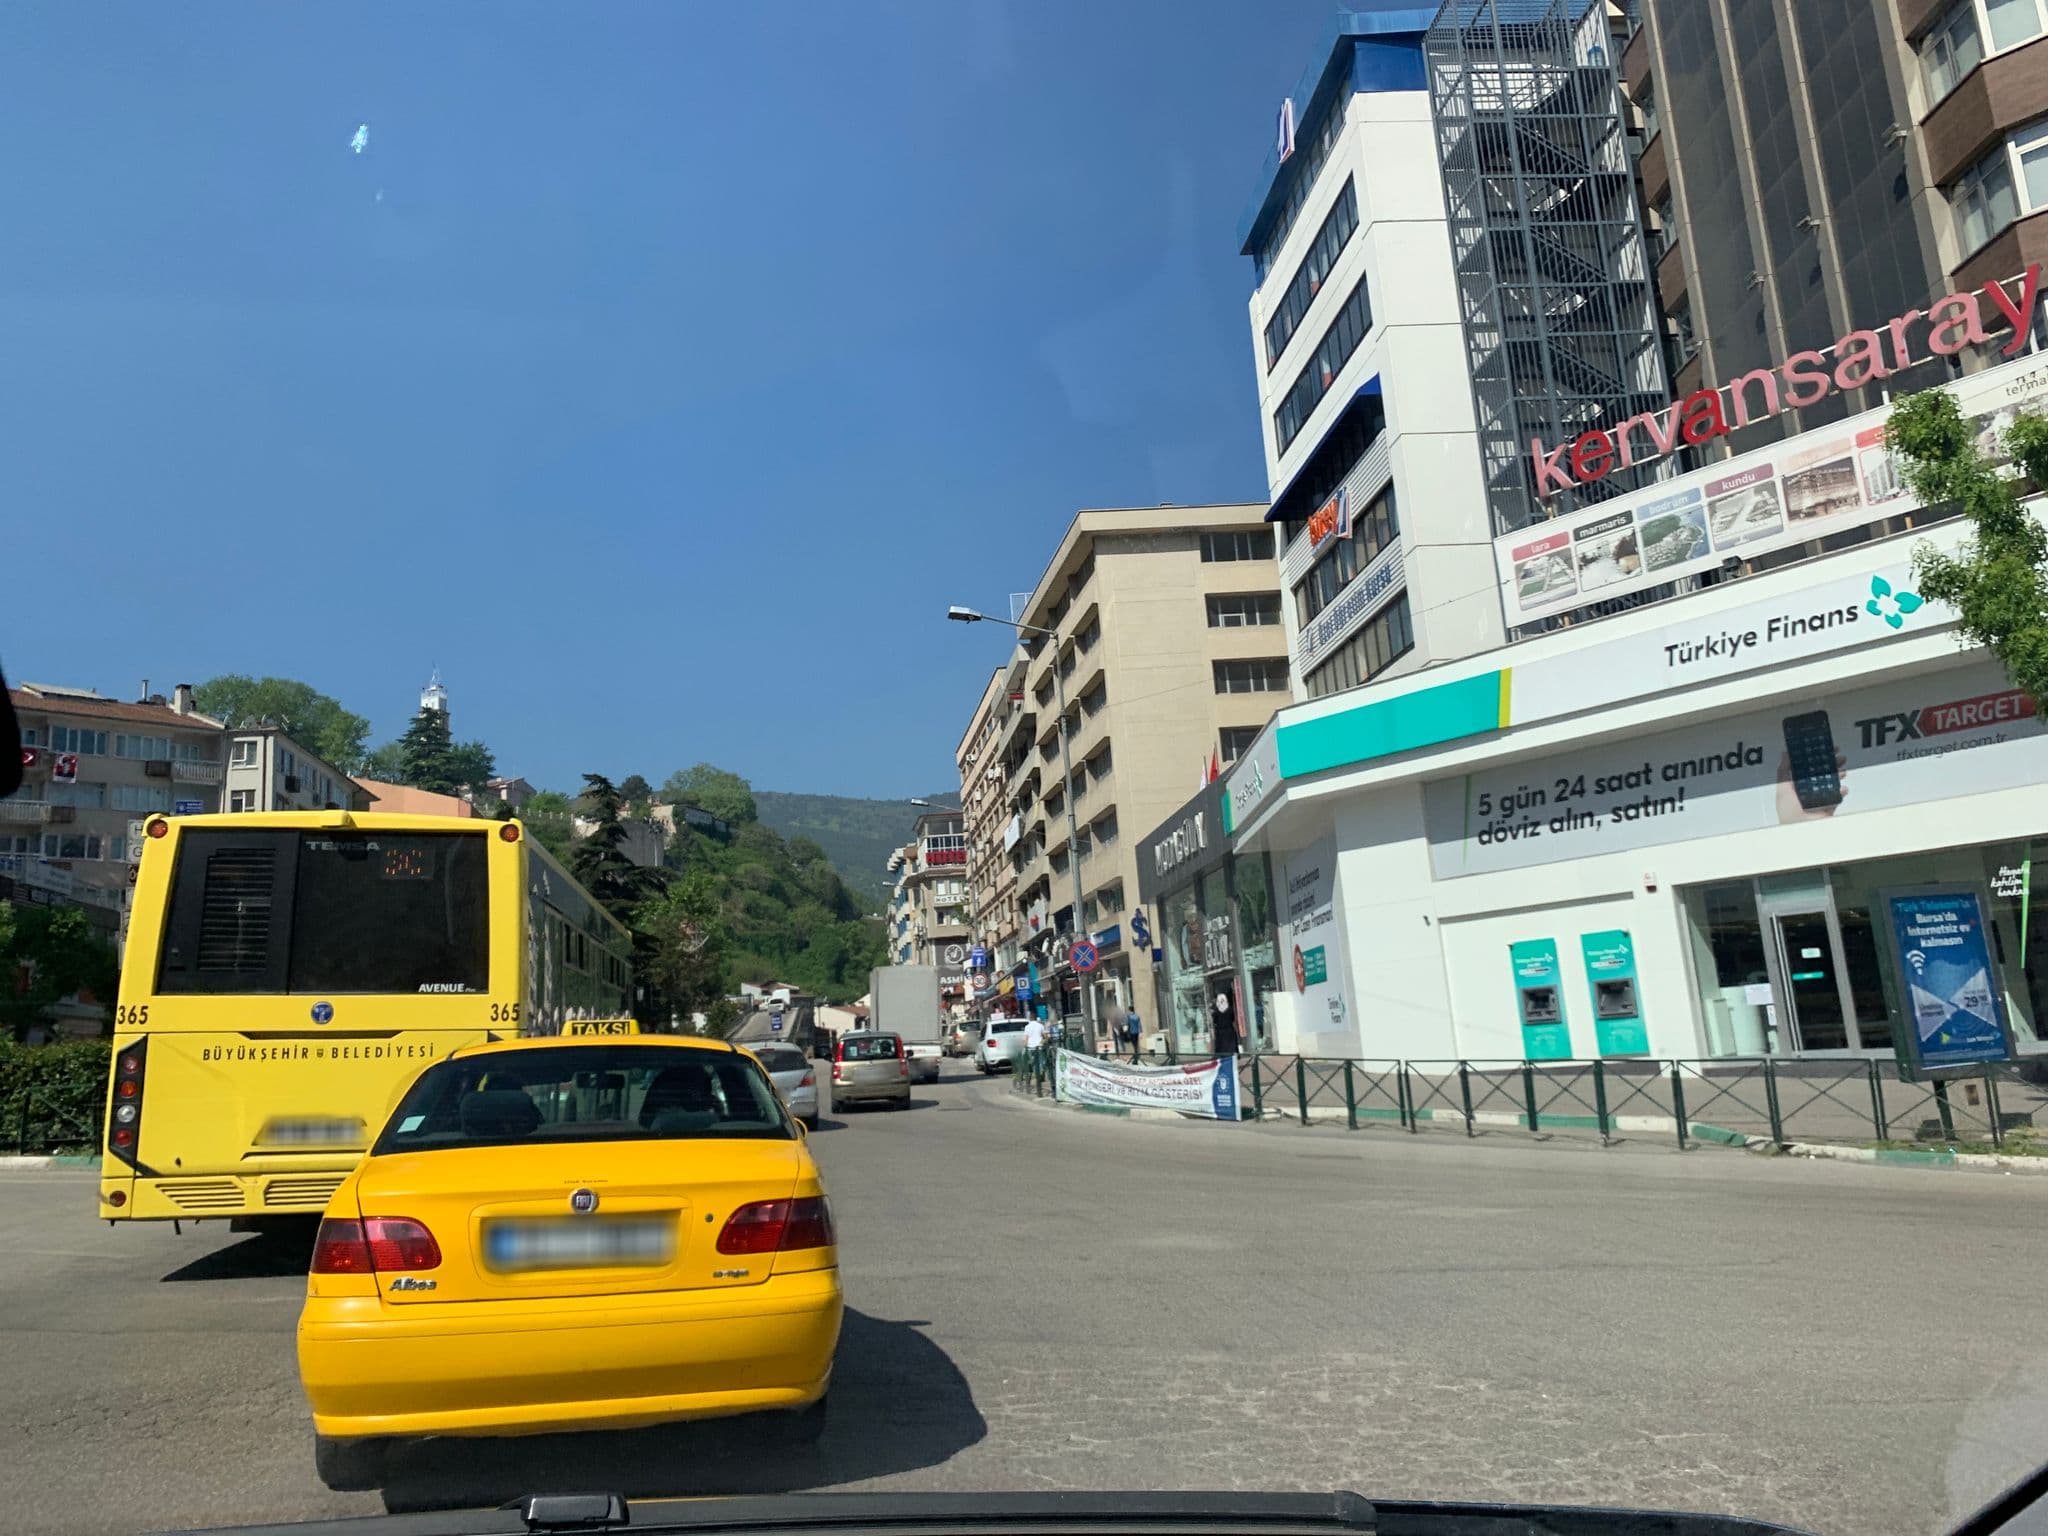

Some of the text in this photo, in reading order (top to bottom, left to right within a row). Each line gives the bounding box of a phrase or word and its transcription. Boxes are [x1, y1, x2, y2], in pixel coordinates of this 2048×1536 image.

[1532, 264, 2042, 498] kervansaray
[2006, 377, 2048, 396] terma
[1721, 472, 1756, 491] kundu
[1649, 495, 1688, 514] bodrum
[1580, 516, 1627, 538] marmaris
[1531, 540, 1550, 553] lara
[1664, 604, 1858, 667] Türkiye Finans
[1854, 694, 2026, 748] TFX TARGET
[1896, 732, 2008, 761] tfxtarget.com.tr
[1478, 742, 1763, 818] 5 gün 24 saat anında
[1478, 786, 1685, 845] döviz alın, satın!
[306, 841, 380, 850] TEMSA
[418, 983, 464, 993] AVENUE
[118, 1005, 148, 1024] 365
[490, 1003, 520, 1021] 365
[573, 1022, 629, 1035] TAKSİ
[203, 1042, 434, 1062] BÜYÜKŞEHİR BELEDİYESİ
